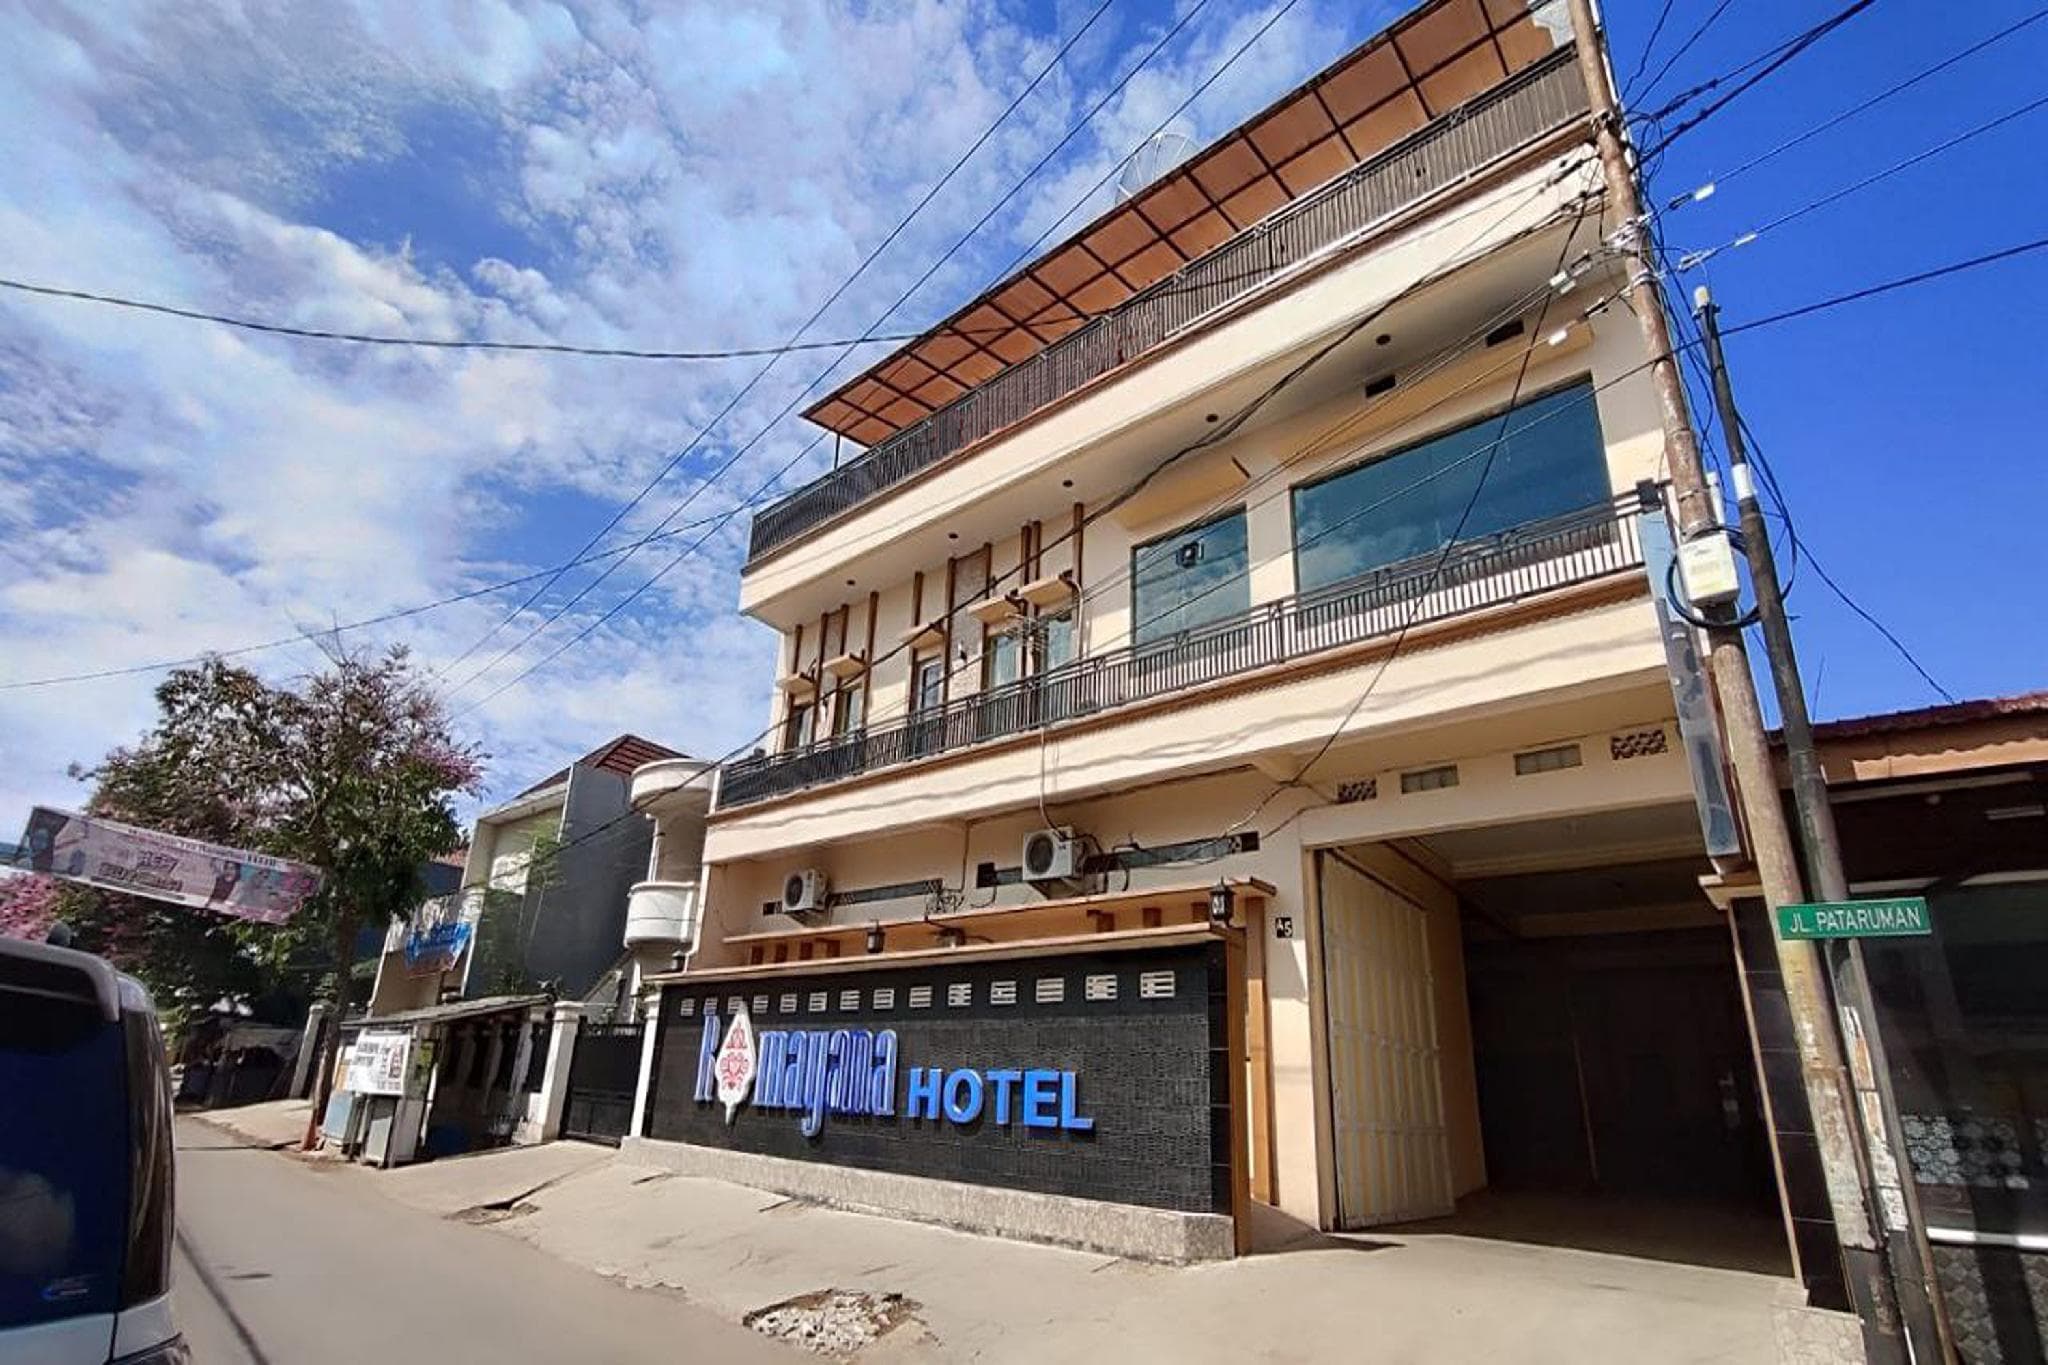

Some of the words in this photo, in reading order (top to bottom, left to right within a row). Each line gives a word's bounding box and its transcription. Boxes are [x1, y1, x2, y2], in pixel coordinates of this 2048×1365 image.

[1815, 906, 1922, 931] PATARUMAN
[694, 1002, 898, 1138] Rmayana
[907, 1067, 1095, 1130] HOTEL
